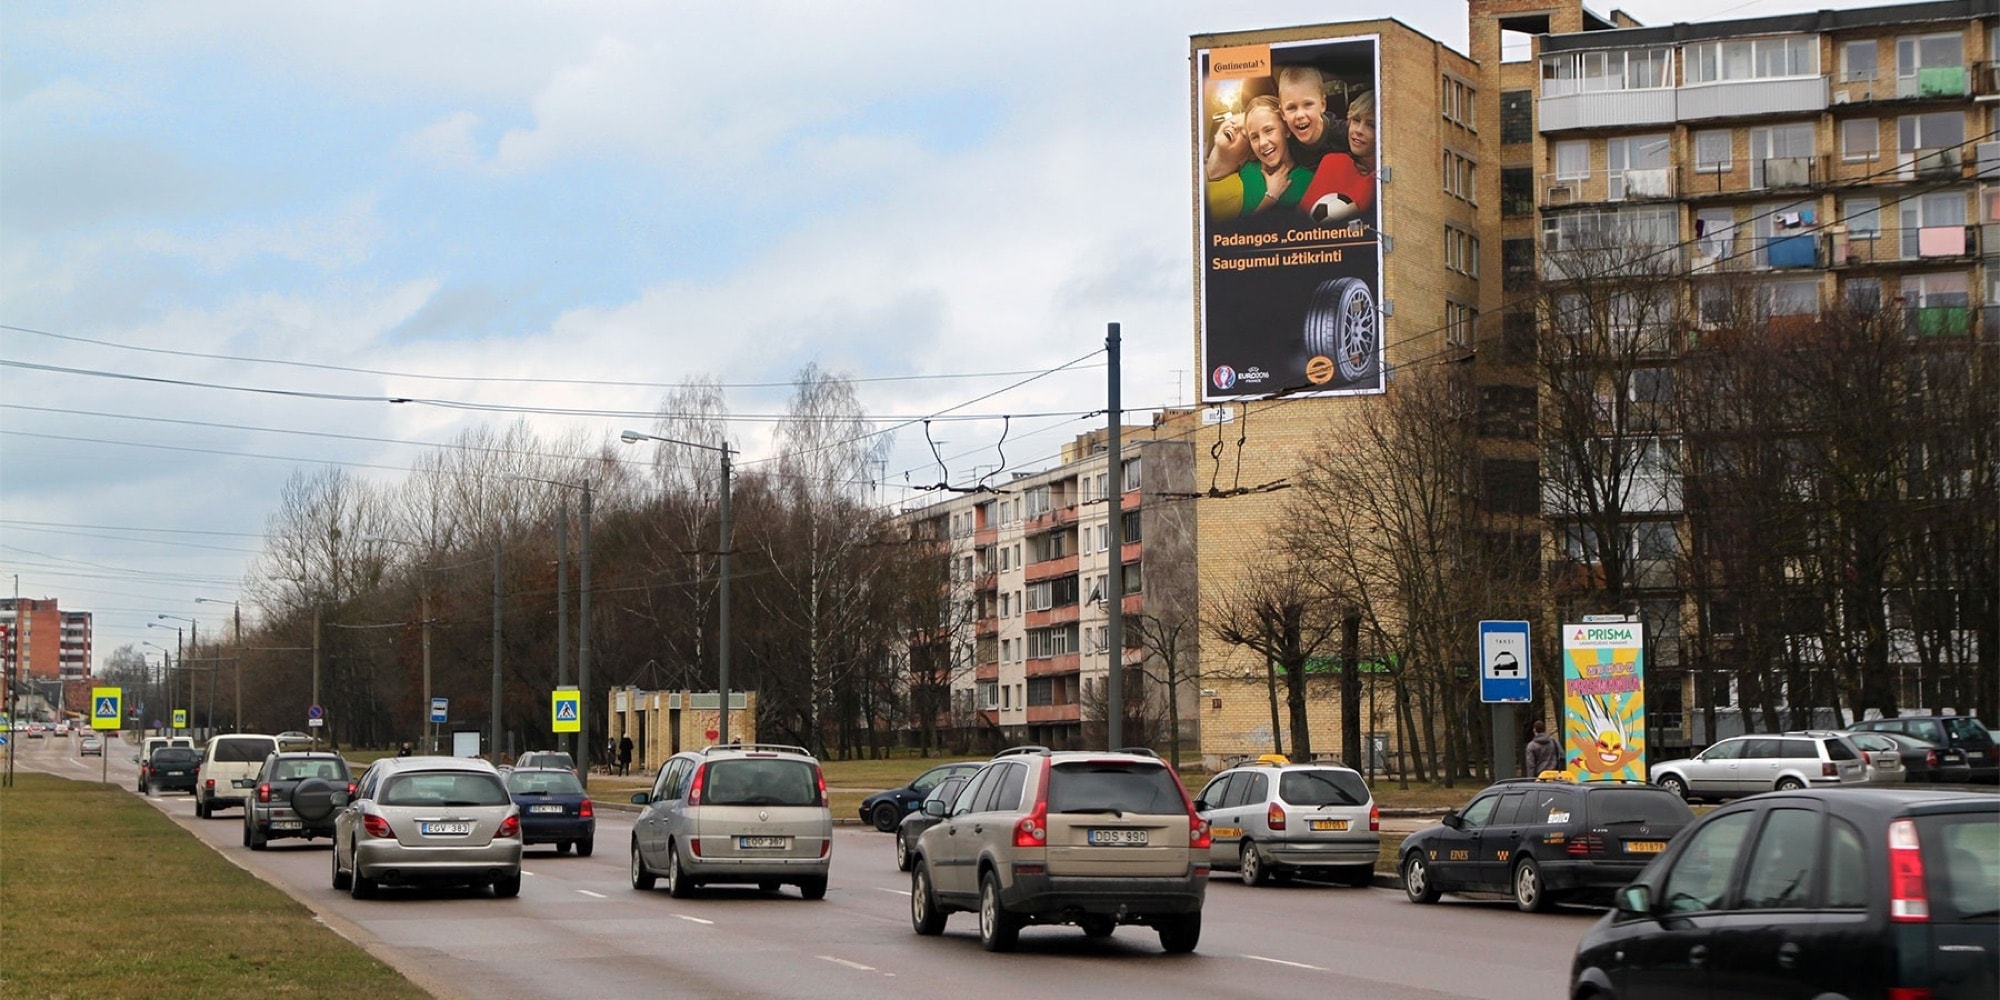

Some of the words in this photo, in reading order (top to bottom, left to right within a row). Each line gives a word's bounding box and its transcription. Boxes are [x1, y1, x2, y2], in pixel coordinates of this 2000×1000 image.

[1213, 60, 1259, 73] Continental
[1213, 232, 1279, 247] Padangos
[1212, 254, 1280, 271] Saugumui
[1282, 250, 1342, 267] užtikrinti
[1587, 628, 1633, 641] PRISMA
[1095, 831, 1120, 842] DDS
[1126, 831, 1145, 842] 990
